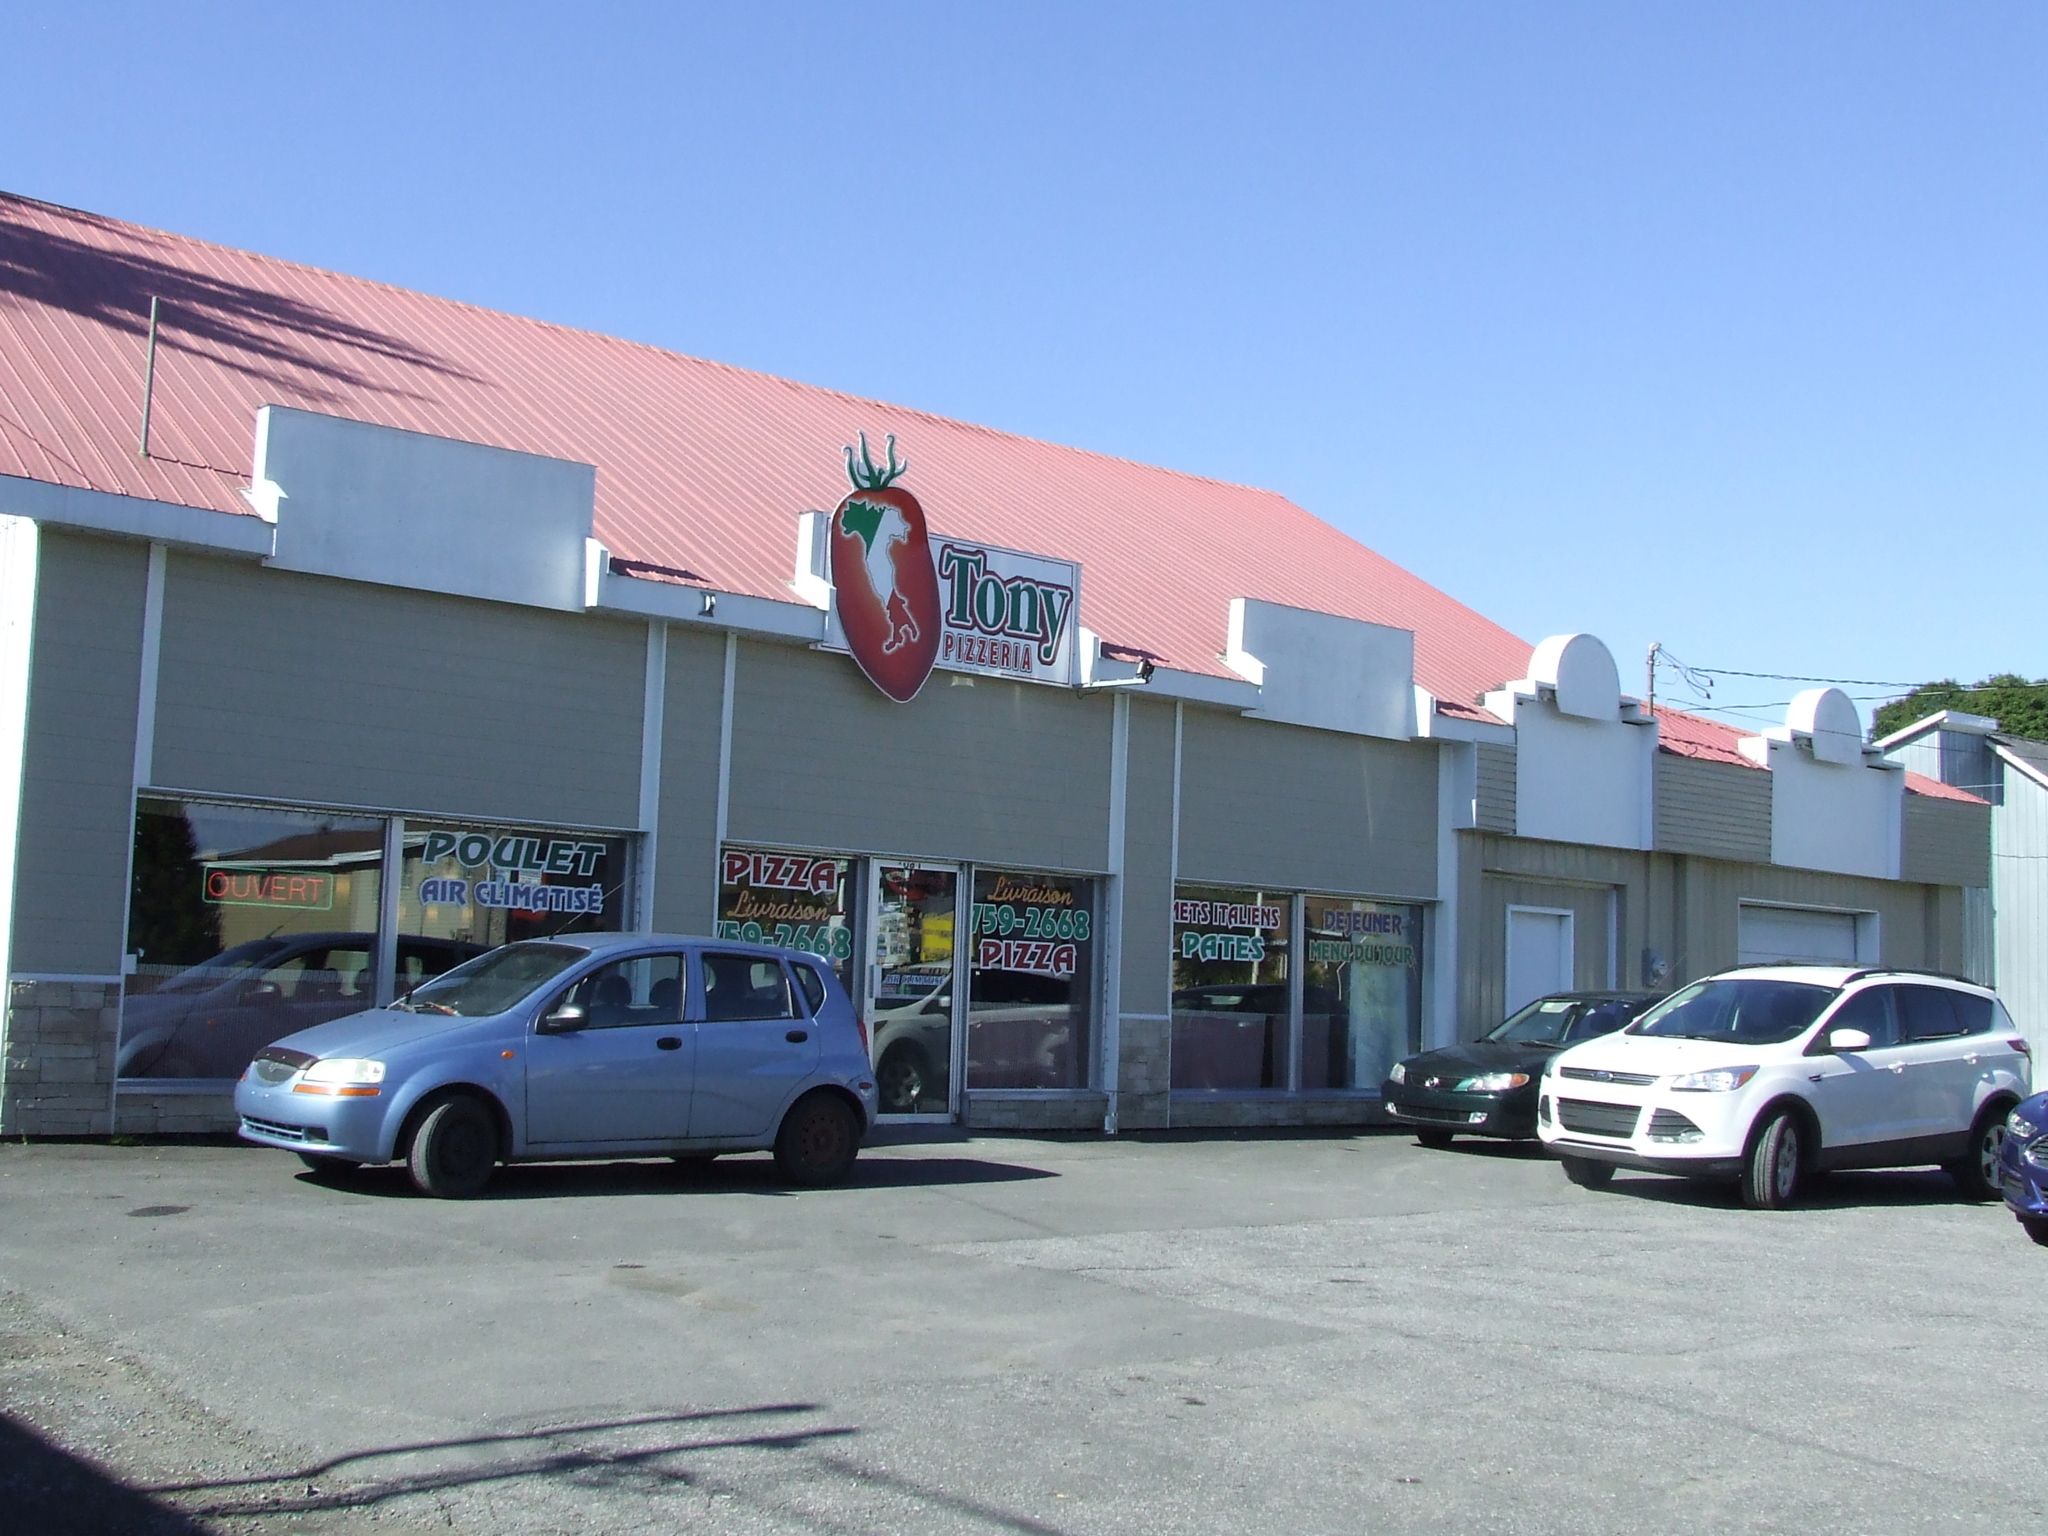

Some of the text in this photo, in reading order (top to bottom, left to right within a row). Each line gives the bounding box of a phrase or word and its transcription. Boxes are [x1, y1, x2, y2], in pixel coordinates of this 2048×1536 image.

[939, 544, 1073, 666] Tony
[943, 631, 1032, 674] PIZZERIA
[421, 830, 606, 876] POULET
[207, 872, 324, 902] OUVERT
[722, 851, 838, 896] PIZZA
[986, 875, 1074, 905] Livraison
[419, 878, 605, 914] AIR CLIMATISÉ
[727, 890, 831, 921] Livraison
[1212, 903, 1280, 930] ITALIENS
[979, 938, 1077, 976] PIZZA
[1181, 931, 1265, 963] PATES
[1309, 940, 1415, 966] MENU DU JOUR
